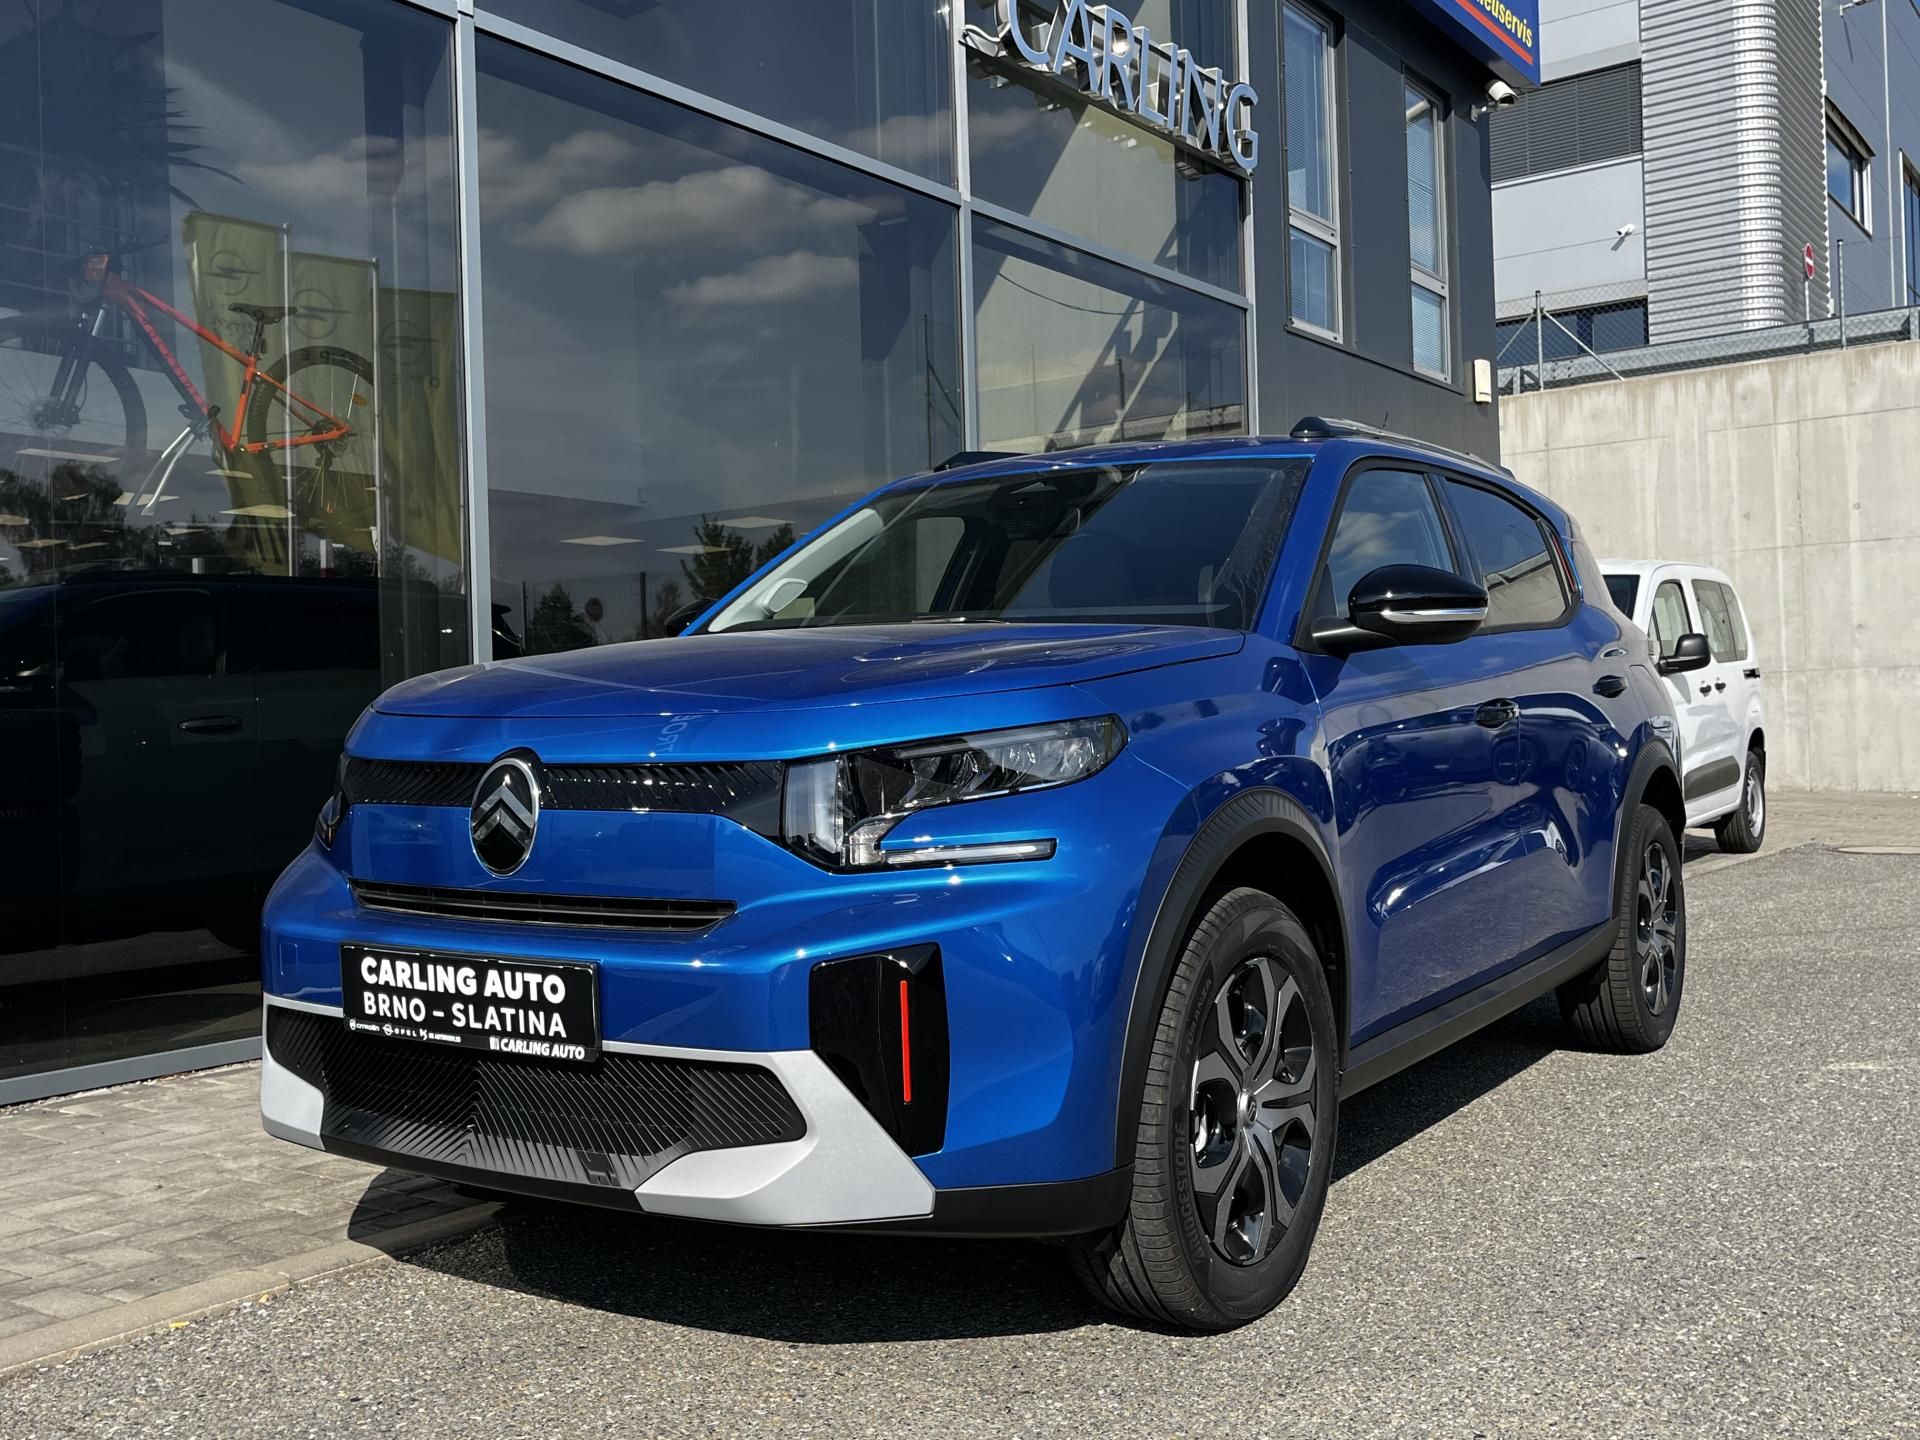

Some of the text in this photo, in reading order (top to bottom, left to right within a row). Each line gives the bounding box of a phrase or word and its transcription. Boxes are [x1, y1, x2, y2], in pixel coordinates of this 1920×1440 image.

[1006, 0, 1259, 170] CARLING
[360, 957, 567, 1004] CARLING AUTO
[363, 991, 426, 1023] BRNO
[452, 1002, 568, 1038] SLATINA
[500, 1037, 586, 1060] CARLING AUTO
